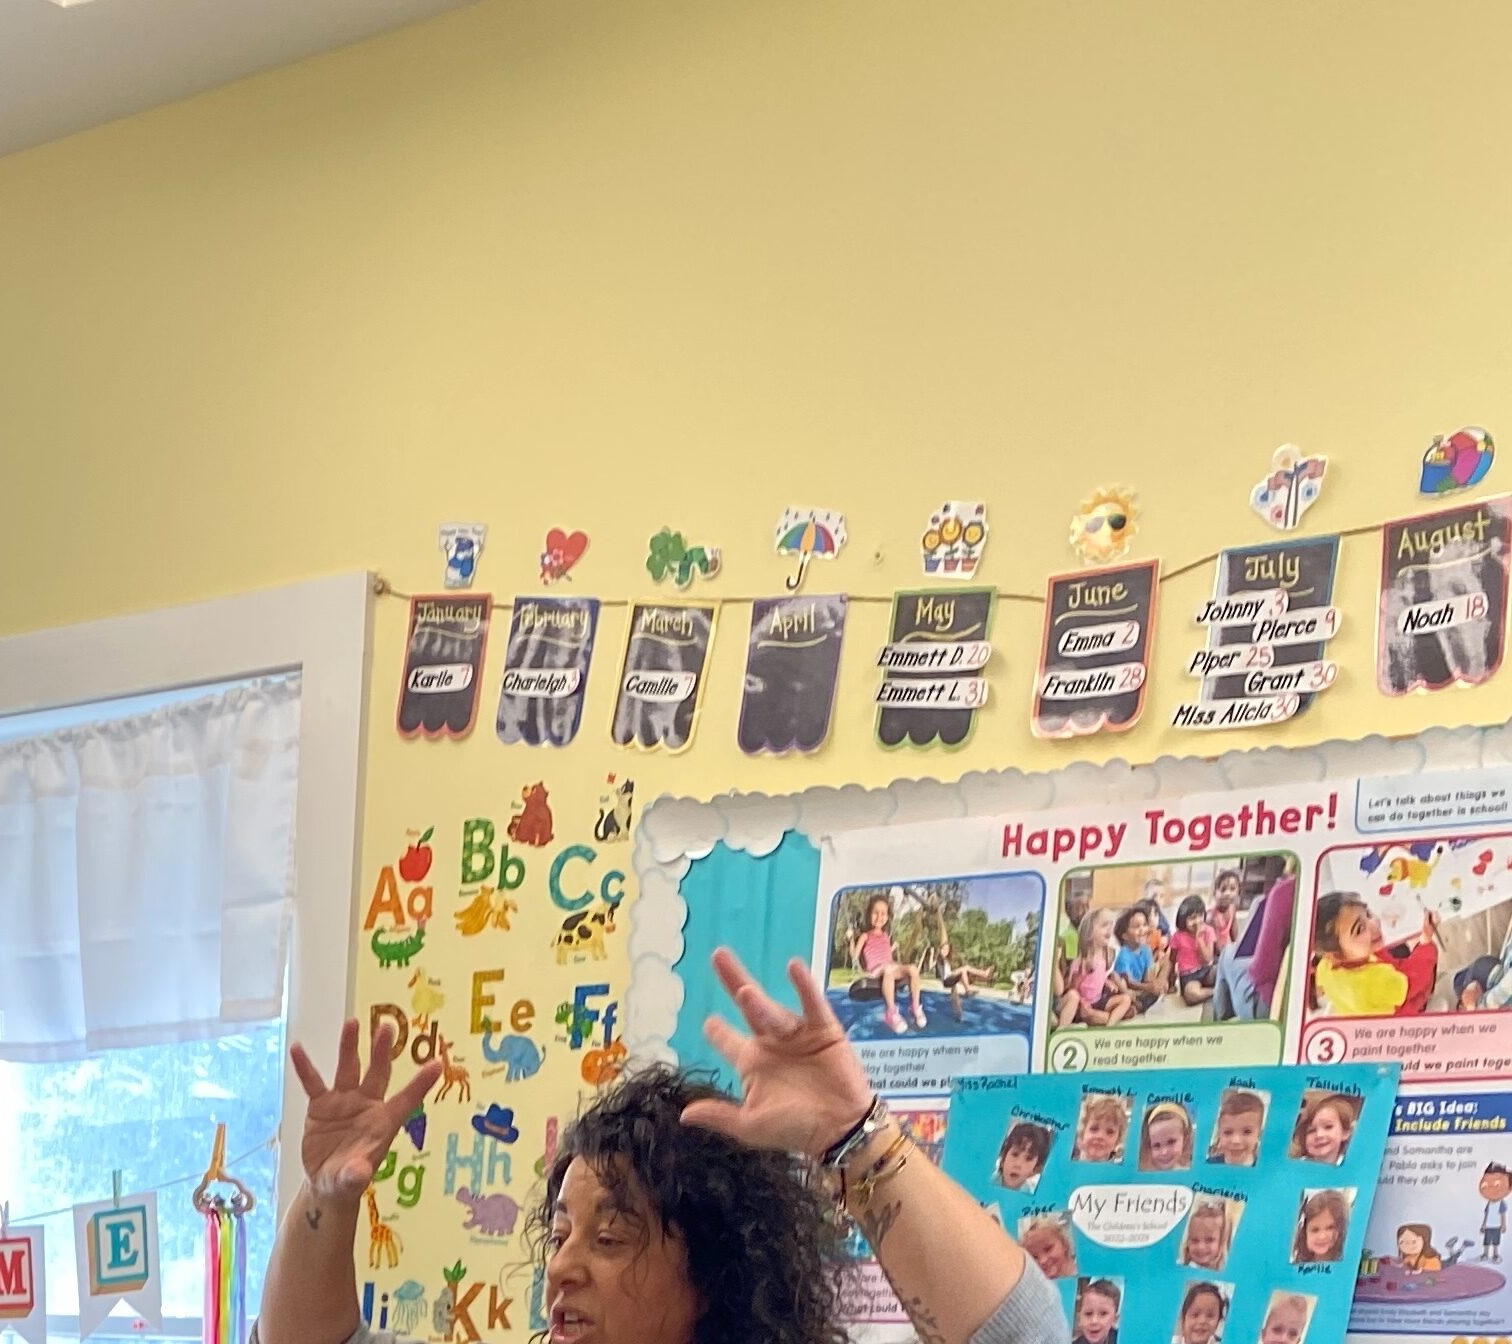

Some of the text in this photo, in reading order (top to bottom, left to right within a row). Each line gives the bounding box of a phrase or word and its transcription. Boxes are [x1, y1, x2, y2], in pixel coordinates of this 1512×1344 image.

[1396, 511, 1491, 559] August
[1245, 553, 1301, 588] July
[1068, 581, 1129, 610] June
[417, 602, 482, 632] January
[518, 603, 589, 638] February
[641, 608, 694, 636] March
[770, 603, 816, 640] April
[916, 597, 956, 631] May
[1196, 598, 1265, 623] Johnny
[1402, 604, 1454, 633] Noah
[1061, 621, 1135, 654] Emma 2
[1257, 617, 1318, 642] Pierce
[877, 647, 947, 666] Emmett
[967, 645, 988, 665] 20
[1189, 646, 1272, 676] Piper 25
[1042, 672, 1116, 697] Franklin
[1247, 662, 1338, 692] Grant 30
[876, 683, 945, 702] Emmett
[1173, 703, 1215, 727] Miss
[1220, 699, 1272, 724] Alicia
[1420, 792, 1451, 803] about
[1002, 793, 1338, 862] Happy Together!
[1407, 807, 1453, 821] together
[462, 818, 525, 889] Bb
[549, 844, 625, 910] Cc
[364, 865, 433, 930] Aa
[470, 969, 535, 1034] Ee
[571, 984, 618, 1050] Ff
[1094, 1035, 1223, 1049] We are happy when we
[1354, 1024, 1497, 1040] We are happy when we
[879, 1049, 895, 1057] are
[898, 1046, 929, 1059] happy
[933, 1045, 961, 1056] when
[964, 1045, 979, 1054] we
[1063, 1047, 1077, 1069] 2
[1093, 1054, 1118, 1065] read
[1317, 1037, 1334, 1062] 3
[1352, 1045, 1383, 1058] paint
[1425, 1059, 1478, 1072] we paint
[890, 1077, 937, 1089] could we
[1407, 1101, 1435, 1117] BIG
[1395, 1115, 1508, 1132] Include Friends
[444, 1133, 512, 1195] Hh
[1072, 1189, 1187, 1221] My Friends
